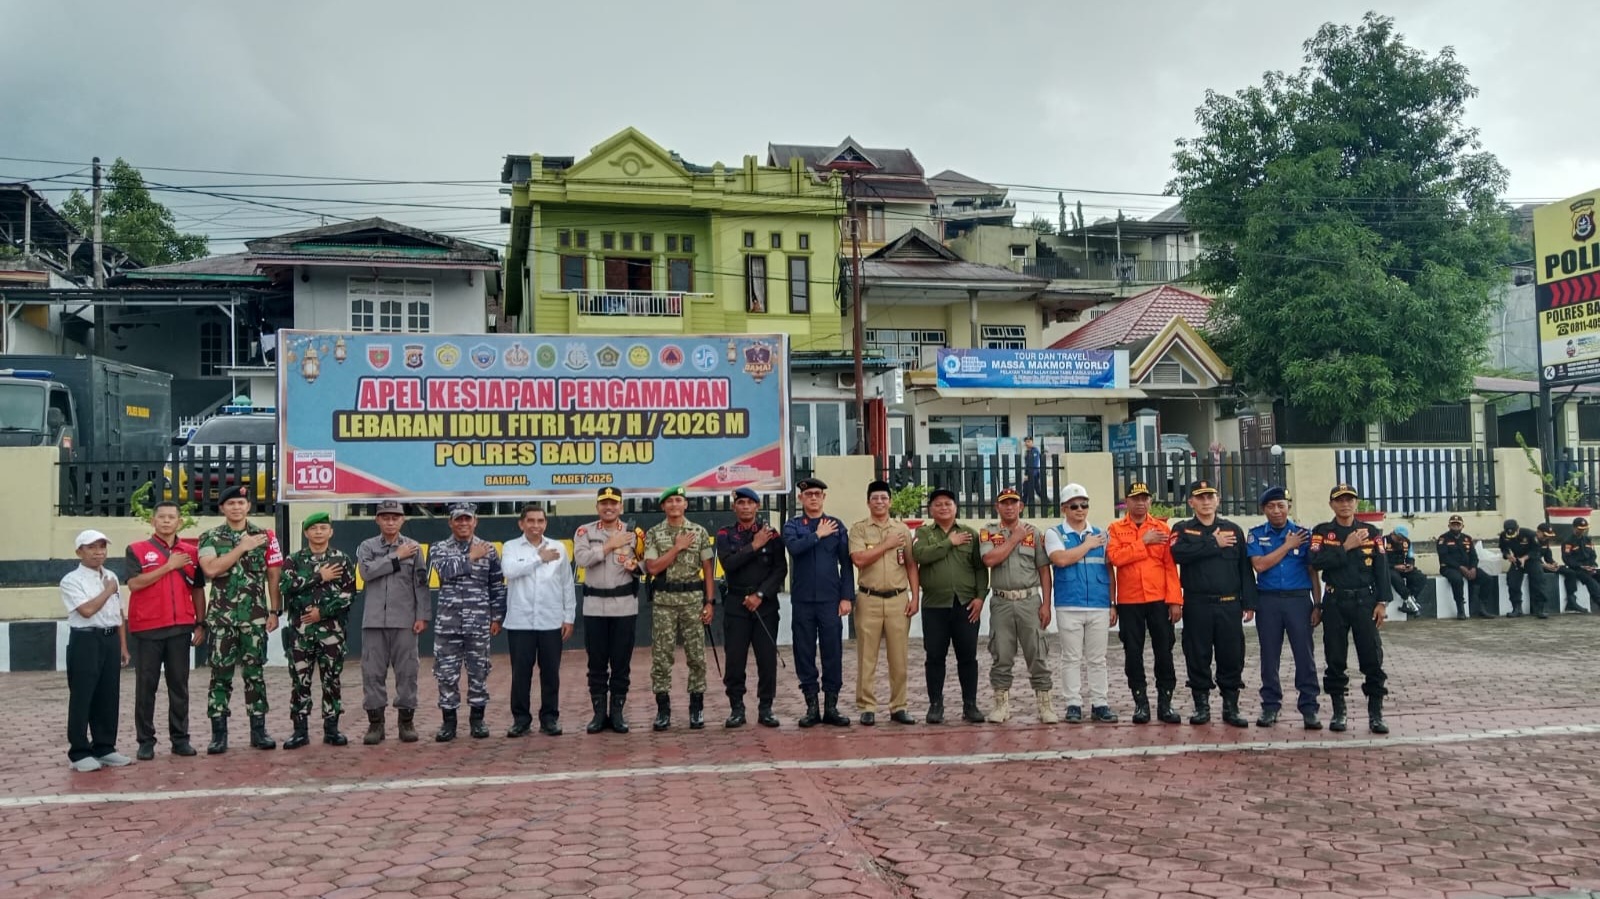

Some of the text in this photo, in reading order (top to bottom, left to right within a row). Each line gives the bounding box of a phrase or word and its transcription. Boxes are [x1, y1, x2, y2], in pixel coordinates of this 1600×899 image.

[1546, 304, 1584, 324] POLRES
[991, 360, 1025, 369] MASSA
[1028, 360, 1072, 370] MAKMOR
[1075, 361, 1110, 370] WORLD
[1014, 352, 1087, 361] TOUR DAN TRAVEL
[358, 379, 729, 410] APEL KESIAPAN PENGAMANAN
[339, 412, 744, 438] LEBARAN IDUL FITRI 1447 H / 2026 M
[435, 441, 654, 466] POLRES BAU BAU
[297, 468, 333, 484] 110
[552, 474, 586, 485] MARET
[587, 473, 613, 484] 2026
